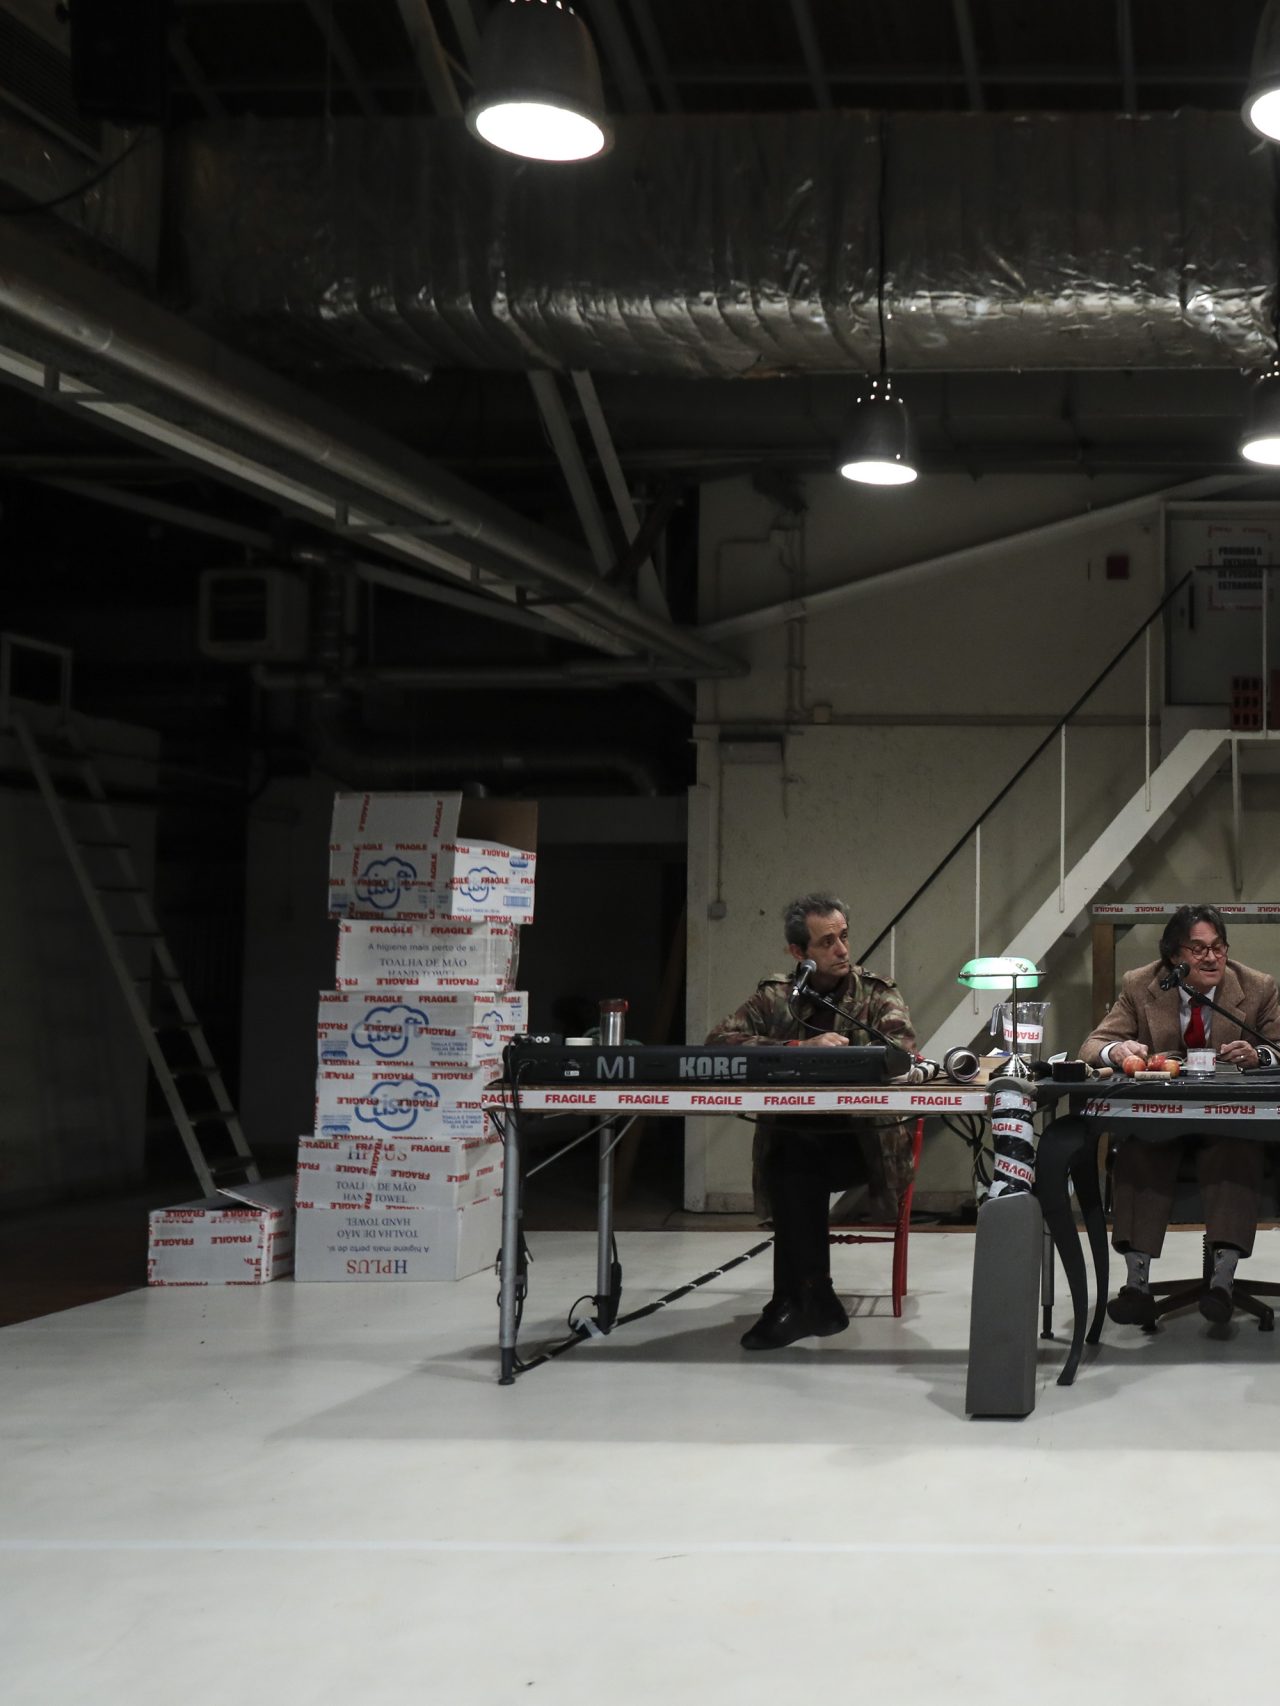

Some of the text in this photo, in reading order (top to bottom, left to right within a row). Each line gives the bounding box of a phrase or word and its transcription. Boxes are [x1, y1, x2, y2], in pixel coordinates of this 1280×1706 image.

[362, 843, 427, 851] AGILE FRAGILE
[370, 925, 473, 936] FRAGILE FRAGILE
[376, 943, 407, 953] higiene
[456, 943, 466, 951] de
[380, 957, 467, 968] TOALHA DE MÃO
[376, 977, 480, 986] FRAGILE FRAGILE
[364, 995, 403, 1003] FRAGILE
[418, 995, 458, 1003] FRAGILE
[596, 1055, 747, 1080] M1 KORG
[372, 1072, 474, 1080] FRAGILE FRAGILE
[337, 1096, 380, 1106] FRAGILE
[545, 1094, 597, 1104] FRAGILE
[618, 1094, 670, 1105] FRAGILE
[691, 1095, 743, 1105] FRAGILE
[764, 1095, 816, 1106] FRAGILE
[837, 1095, 889, 1105] FRAGILE
[910, 1096, 963, 1106] FRAGILE
[1131, 1103, 1183, 1113] FRAGILE
[1204, 1104, 1256, 1114] FRAGILE
[992, 1122, 1024, 1134] AGILE
[411, 1144, 451, 1153] FRAGILE
[336, 1163, 373, 1174] RAGILE
[391, 1169, 431, 1180] FRAGILE
[997, 1160, 1035, 1182] FRAGIL
[377, 1182, 392, 1191] DE
[393, 1180, 417, 1191] MÃO
[165, 1209, 206, 1218] FRAGILE
[347, 1217, 411, 1226] HAND TOWEL
[361, 1230, 377, 1239] DE
[377, 1229, 418, 1238] TOALHA
[153, 1235, 252, 1247] FRAGILE FRAGILE
[346, 1259, 408, 1275] HPLUS
